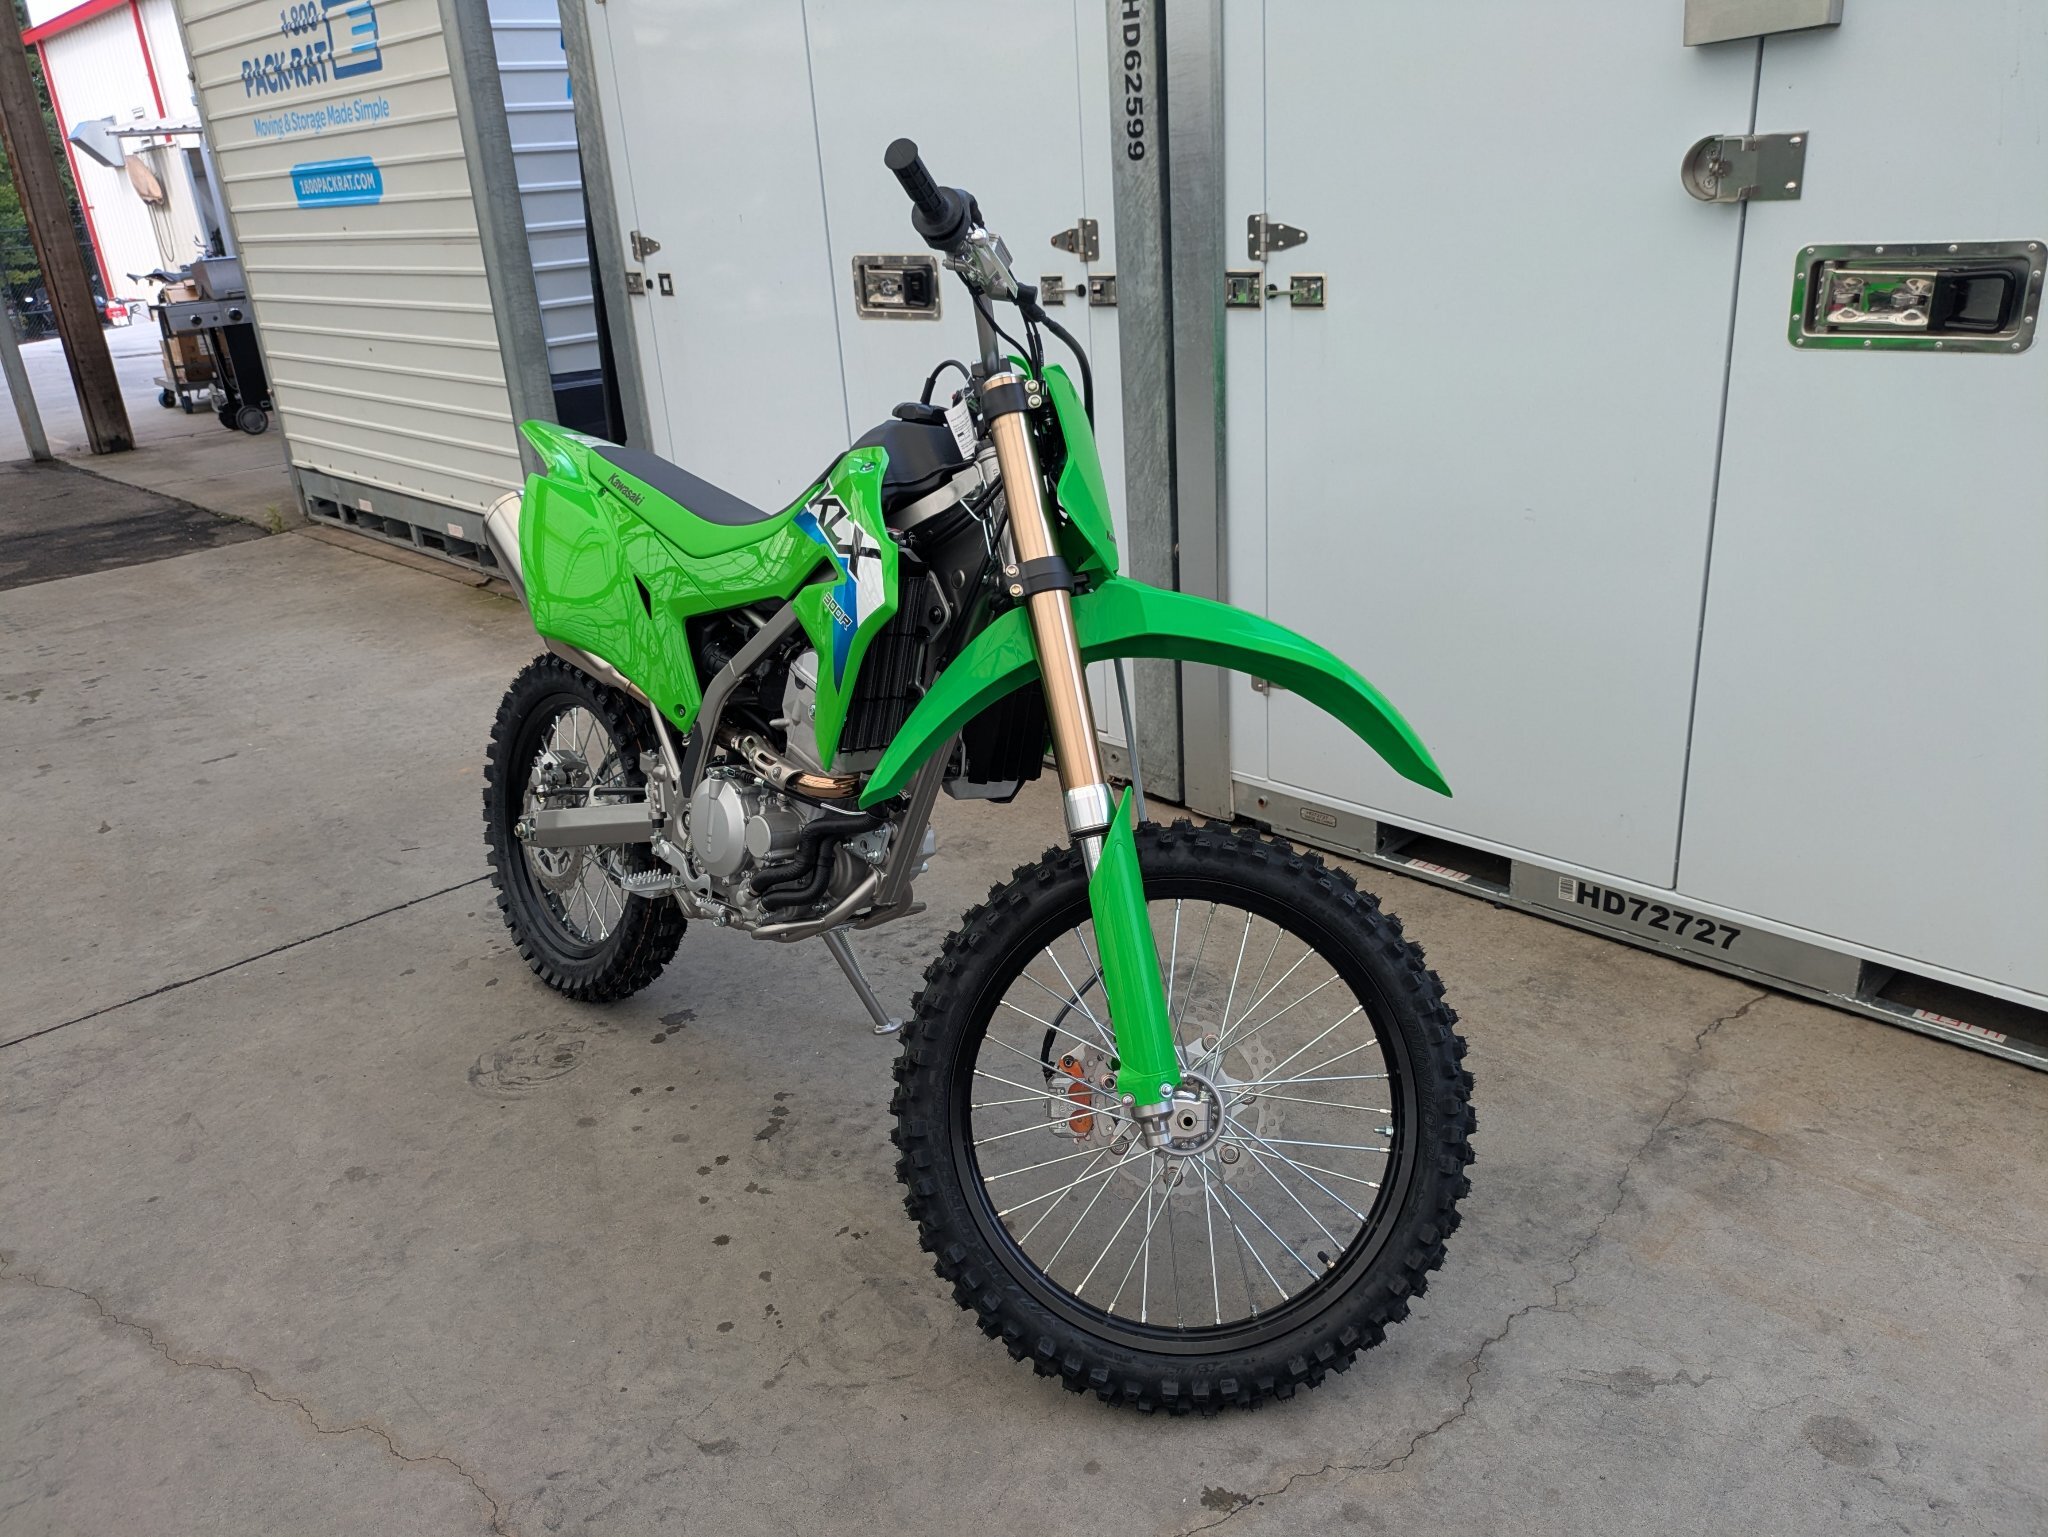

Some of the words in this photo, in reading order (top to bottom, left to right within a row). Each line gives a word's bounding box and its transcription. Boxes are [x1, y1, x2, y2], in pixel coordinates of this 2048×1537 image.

[1122, 0, 1145, 161] HD62599
[254, 115, 283, 140] Moving
[284, 113, 291, 132] &
[291, 109, 326, 134] Storage
[326, 103, 353, 127] Made
[354, 96, 390, 126] Simple
[299, 172, 376, 195] 1800PACKRAT.COM
[608, 472, 645, 507] Kawasaki
[806, 479, 881, 582] KLX
[823, 592, 852, 631] 300R
[1577, 882, 1741, 950] HD72727
